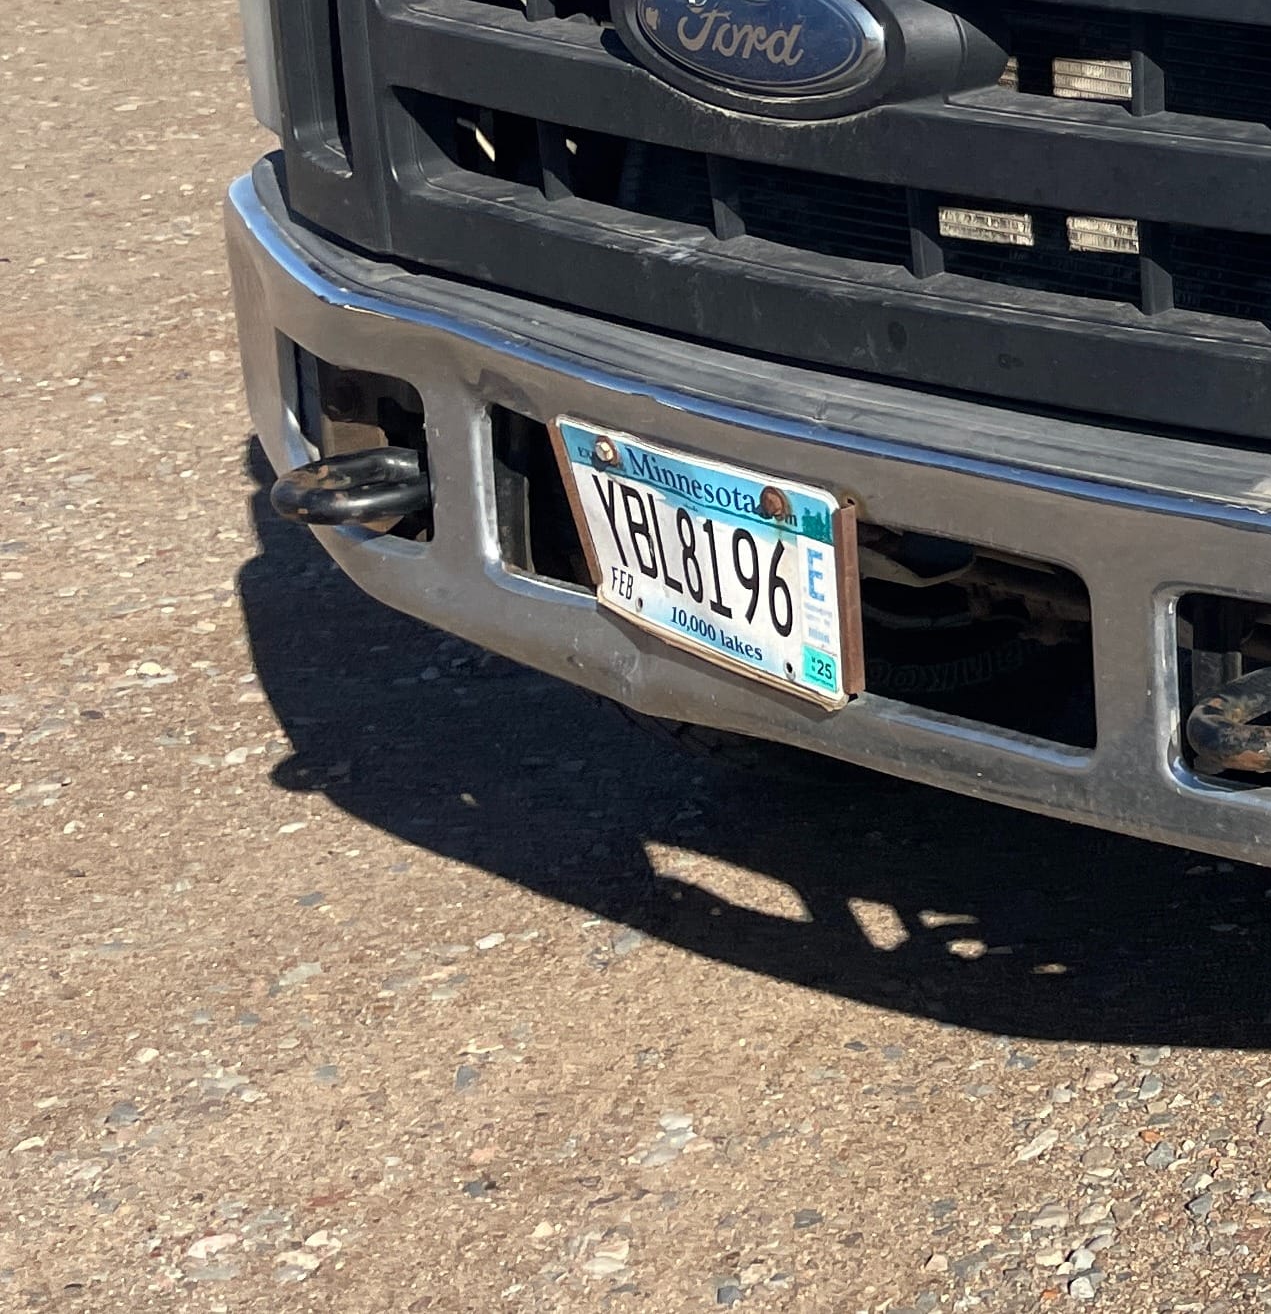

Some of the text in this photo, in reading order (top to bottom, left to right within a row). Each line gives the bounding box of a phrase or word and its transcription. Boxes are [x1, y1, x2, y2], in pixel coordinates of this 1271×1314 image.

[627, 447, 756, 514] Minnesota
[591, 474, 793, 638] YBL8196
[610, 566, 635, 601] FEB
[670, 605, 763, 662] 10,000 lakes
[816, 659, 833, 680] 25
